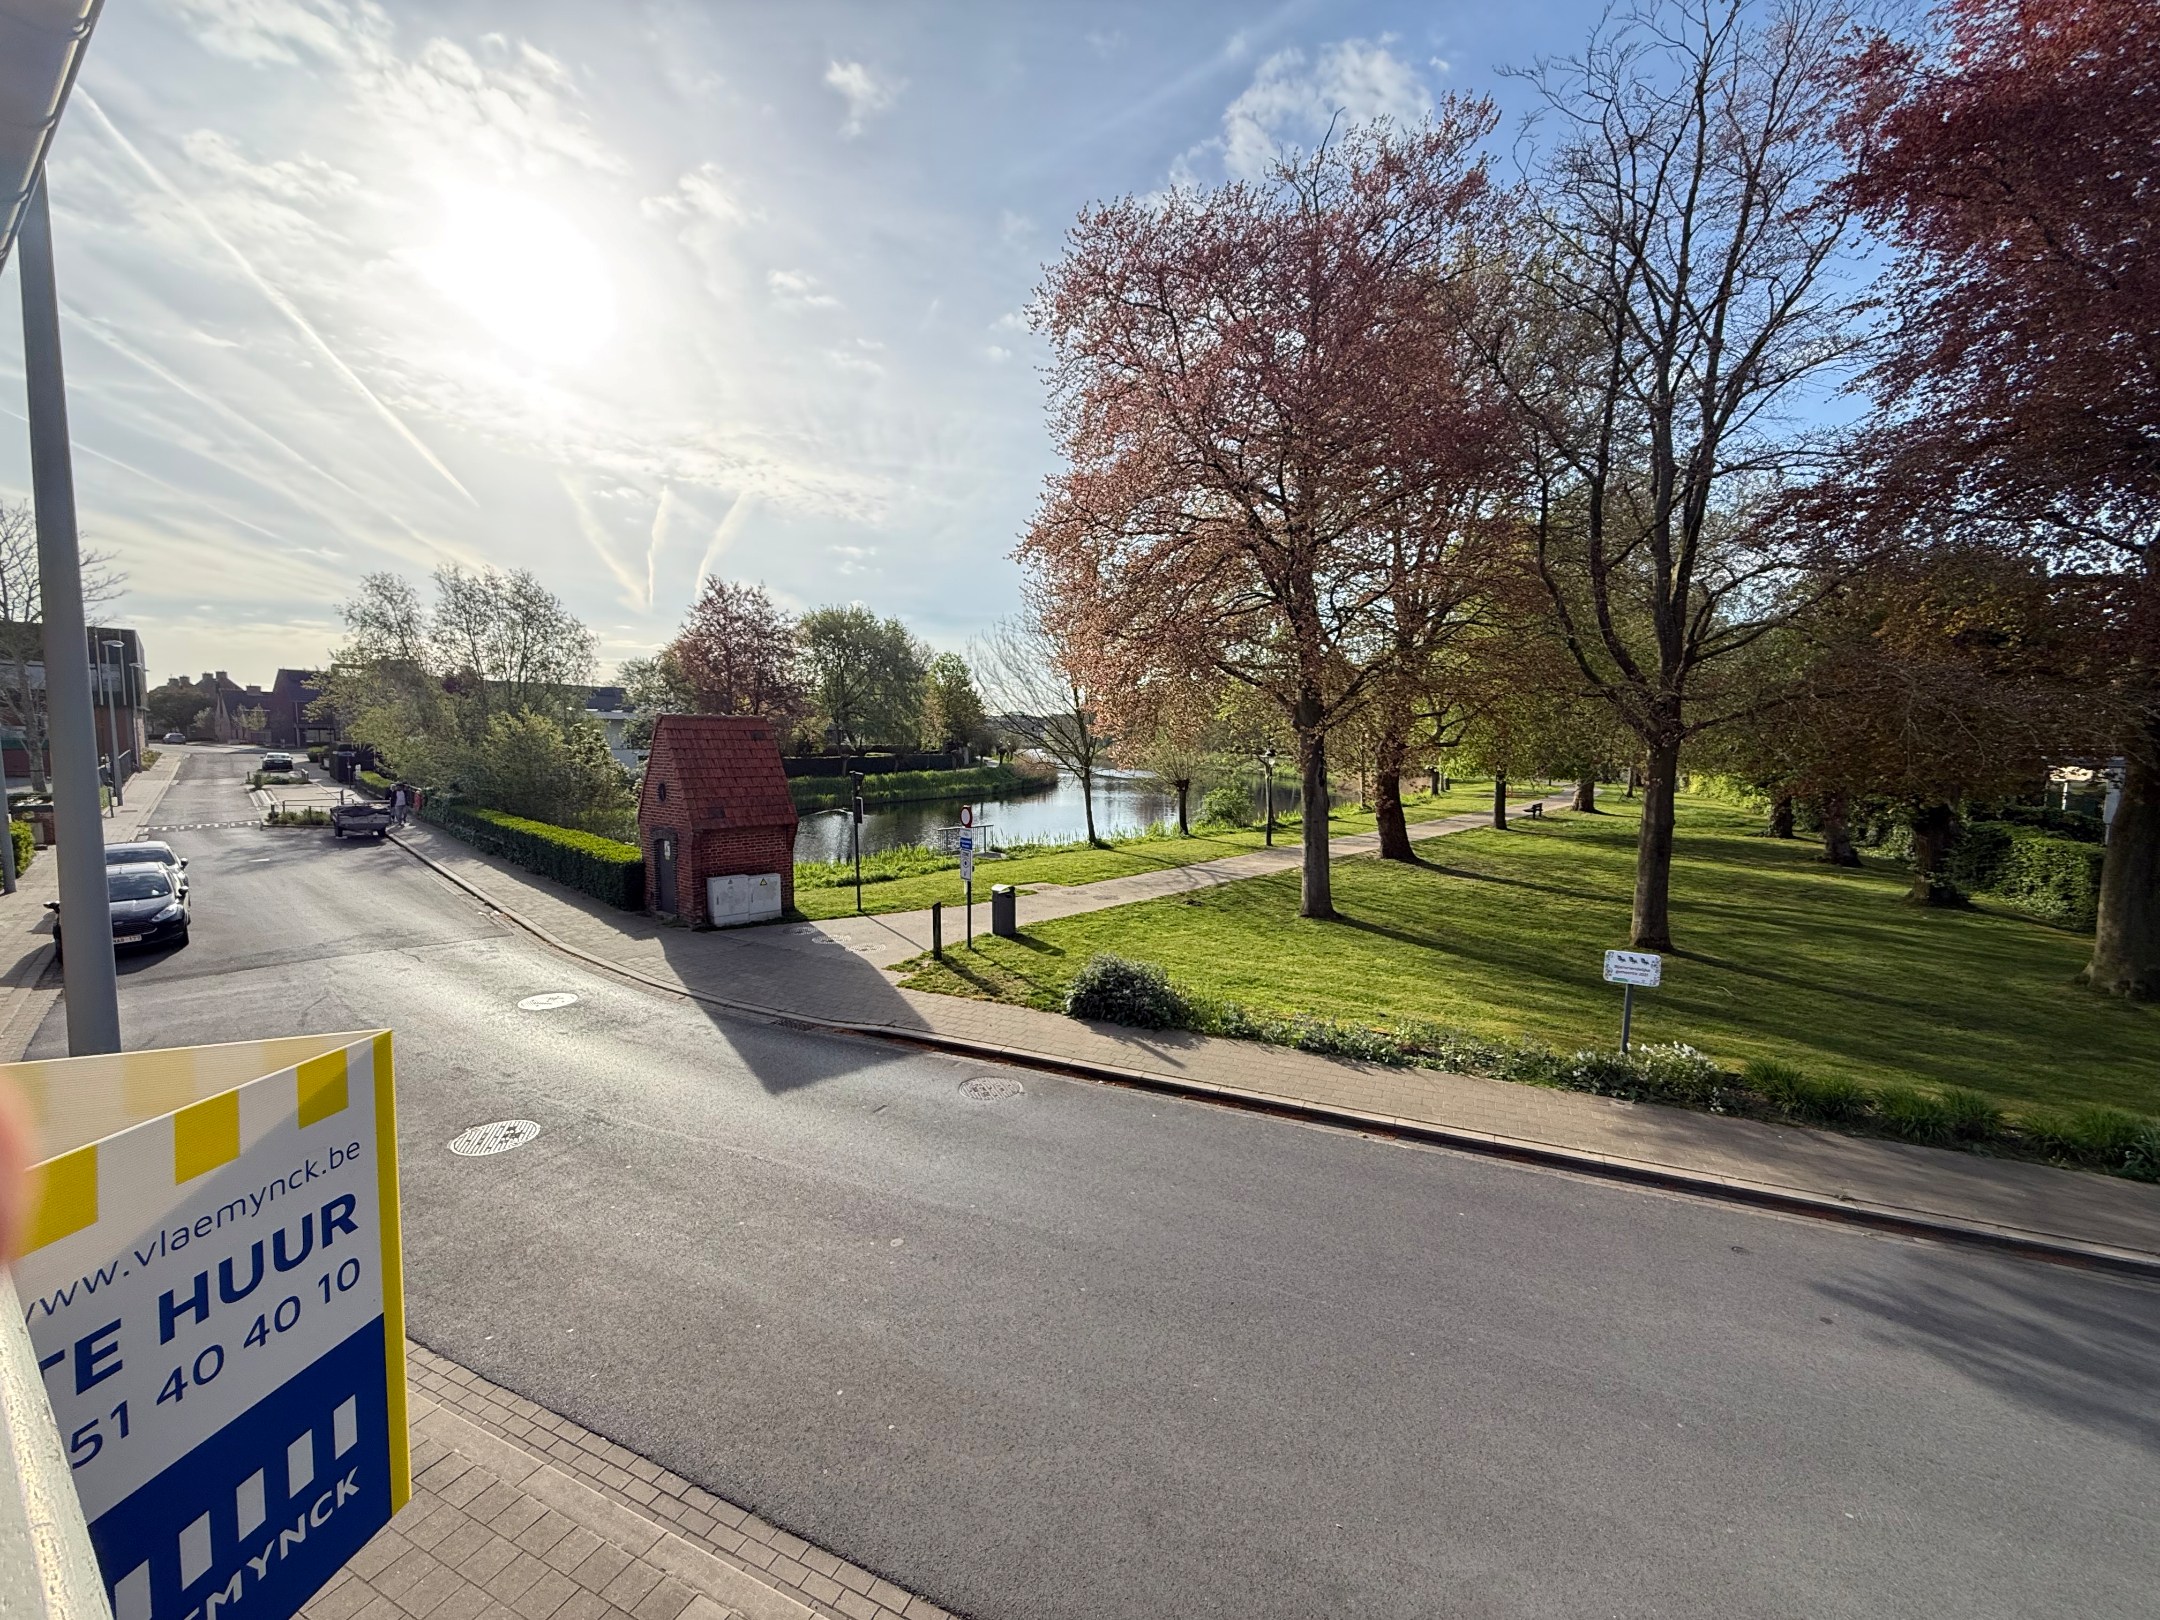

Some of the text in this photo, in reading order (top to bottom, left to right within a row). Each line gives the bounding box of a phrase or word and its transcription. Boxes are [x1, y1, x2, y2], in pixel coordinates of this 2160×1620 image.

[156, 1344, 225, 1406] 40
[243, 1296, 301, 1349] 40
[318, 1257, 360, 1304] 10
[159, 1193, 359, 1345] HUUR
[184, 1466, 360, 1620] MYNCK
